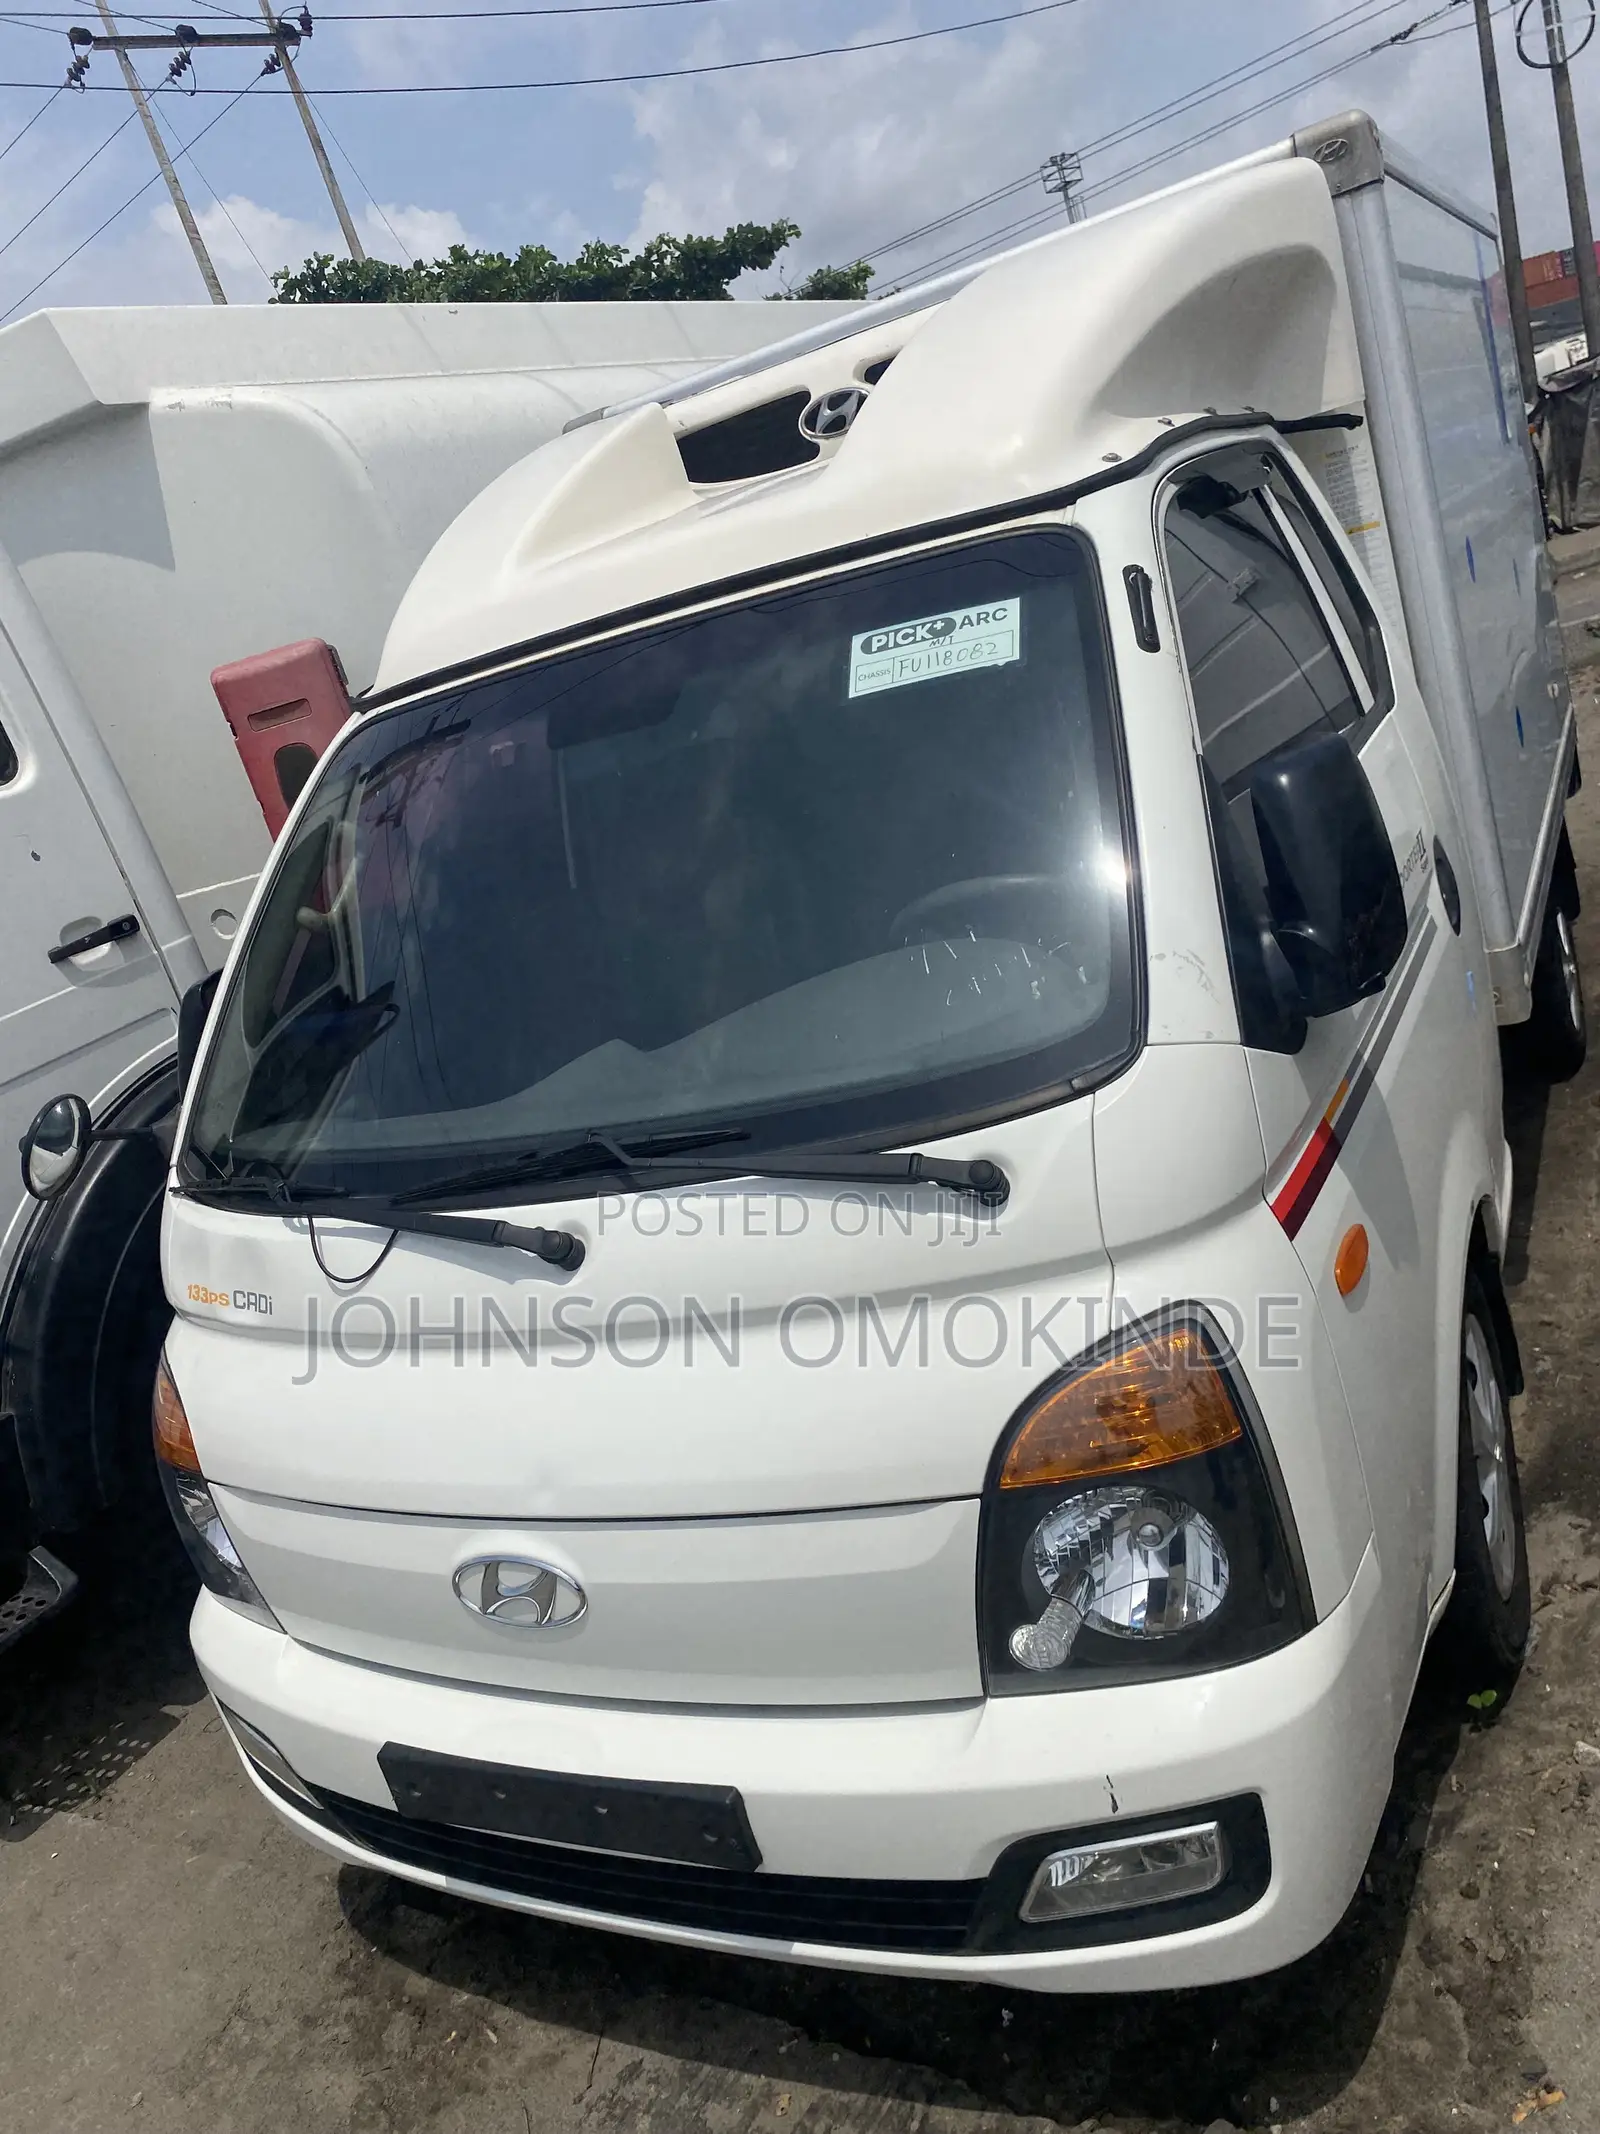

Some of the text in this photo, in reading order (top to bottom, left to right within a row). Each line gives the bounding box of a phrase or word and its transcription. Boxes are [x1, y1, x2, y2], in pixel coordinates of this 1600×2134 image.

[959, 607, 1008, 630] ARC
[900, 642, 998, 677] FU118082
[858, 667, 892, 682] CHASSIS
